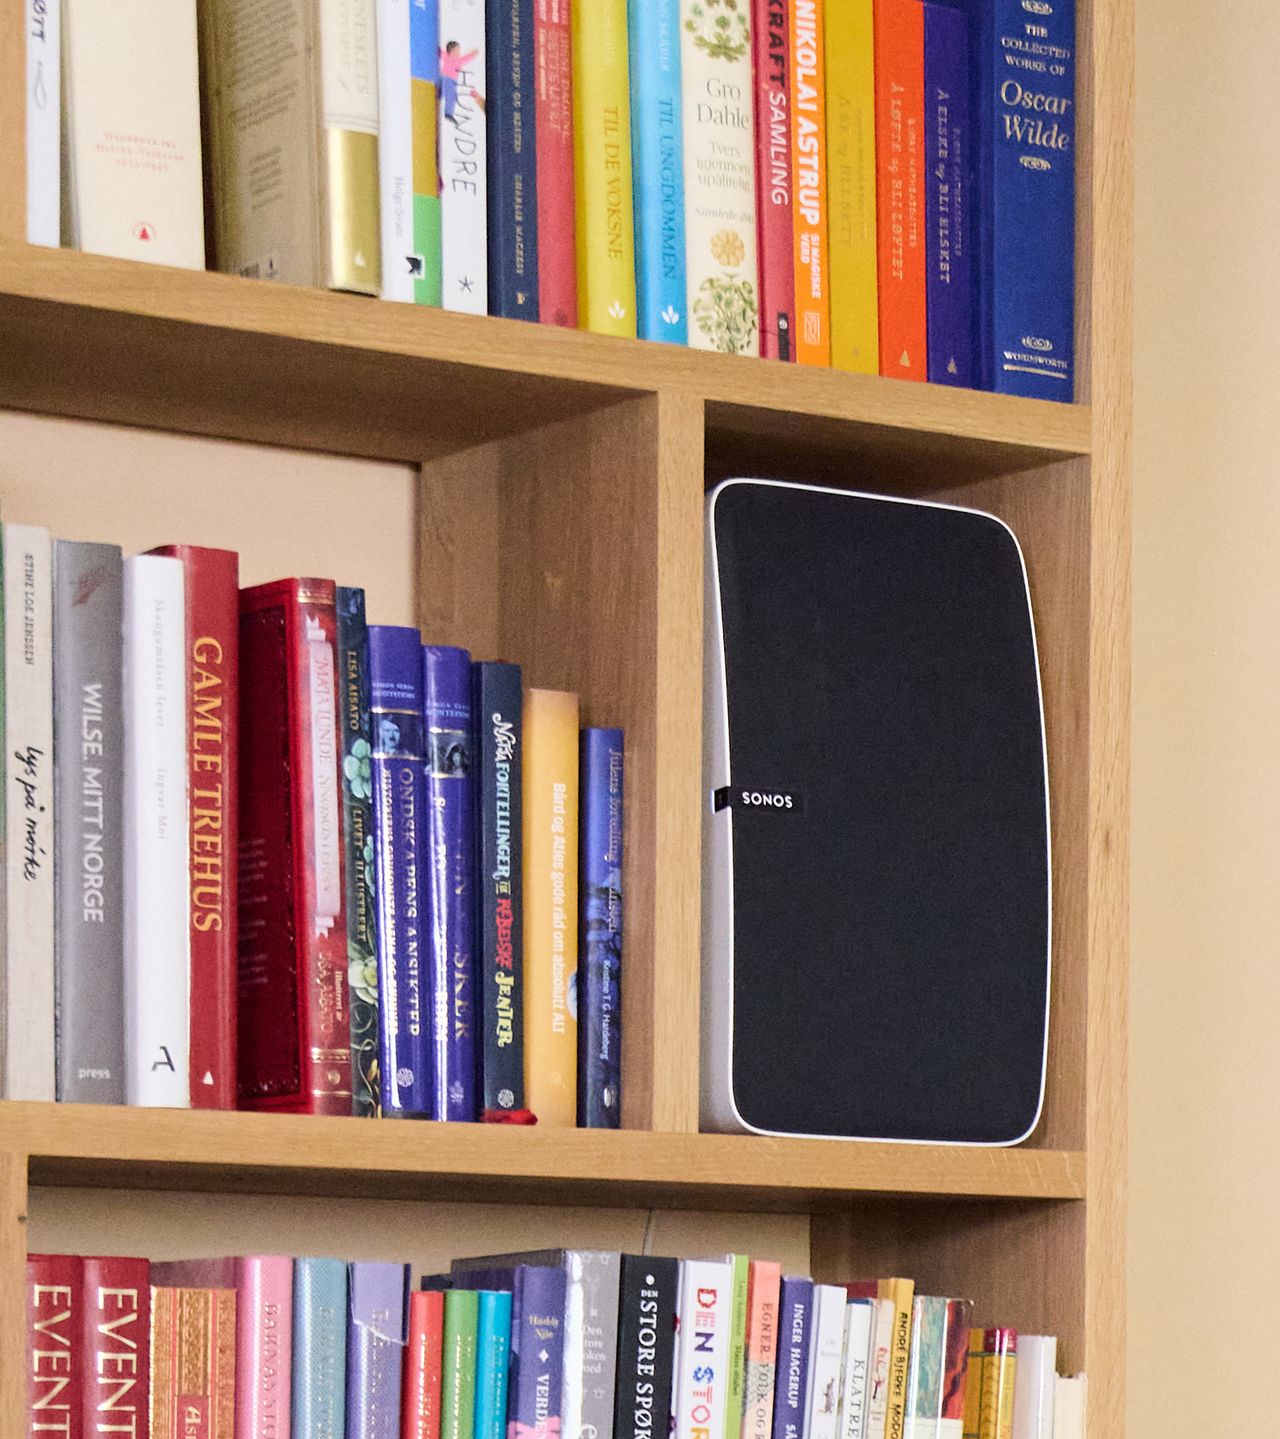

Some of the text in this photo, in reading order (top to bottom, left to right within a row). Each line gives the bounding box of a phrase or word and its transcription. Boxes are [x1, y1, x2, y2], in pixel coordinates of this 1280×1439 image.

[1001, 37, 1070, 59] COLLECTED
[698, 103, 750, 130] Dahle
[706, 78, 741, 100] Gro
[795, 1, 819, 225] NIKOLAI ASTRUP
[1001, 80, 1071, 115] Oscar
[453, 69, 477, 196] HUNDRE
[768, 92, 788, 205] SAMLING
[1003, 115, 1070, 150] Wilde
[603, 107, 622, 259] TIL DE VOKSNE
[659, 98, 677, 280] TIL UNGDOMMEN
[25, 592, 35, 613] LOE
[347, 651, 359, 730] LISA AISATO
[15, 747, 45, 810] lys på
[82, 683, 103, 923] WILSE. MITT NORGE
[192, 637, 223, 932] GAMLE TREHUS
[742, 791, 793, 809] SONOS
[399, 767, 417, 918] ONDSKAPENS
[551, 782, 567, 1034] Bård og gode råd om absolutt ALT
[494, 971, 514, 1047] JENTER
[79, 1068, 111, 1079] press
[636, 1300, 658, 1376] STORE
[693, 1286, 718, 1353] DEN
[787, 1303, 804, 1408] INGER HAGERUP
[756, 1408, 768, 1428] OG
